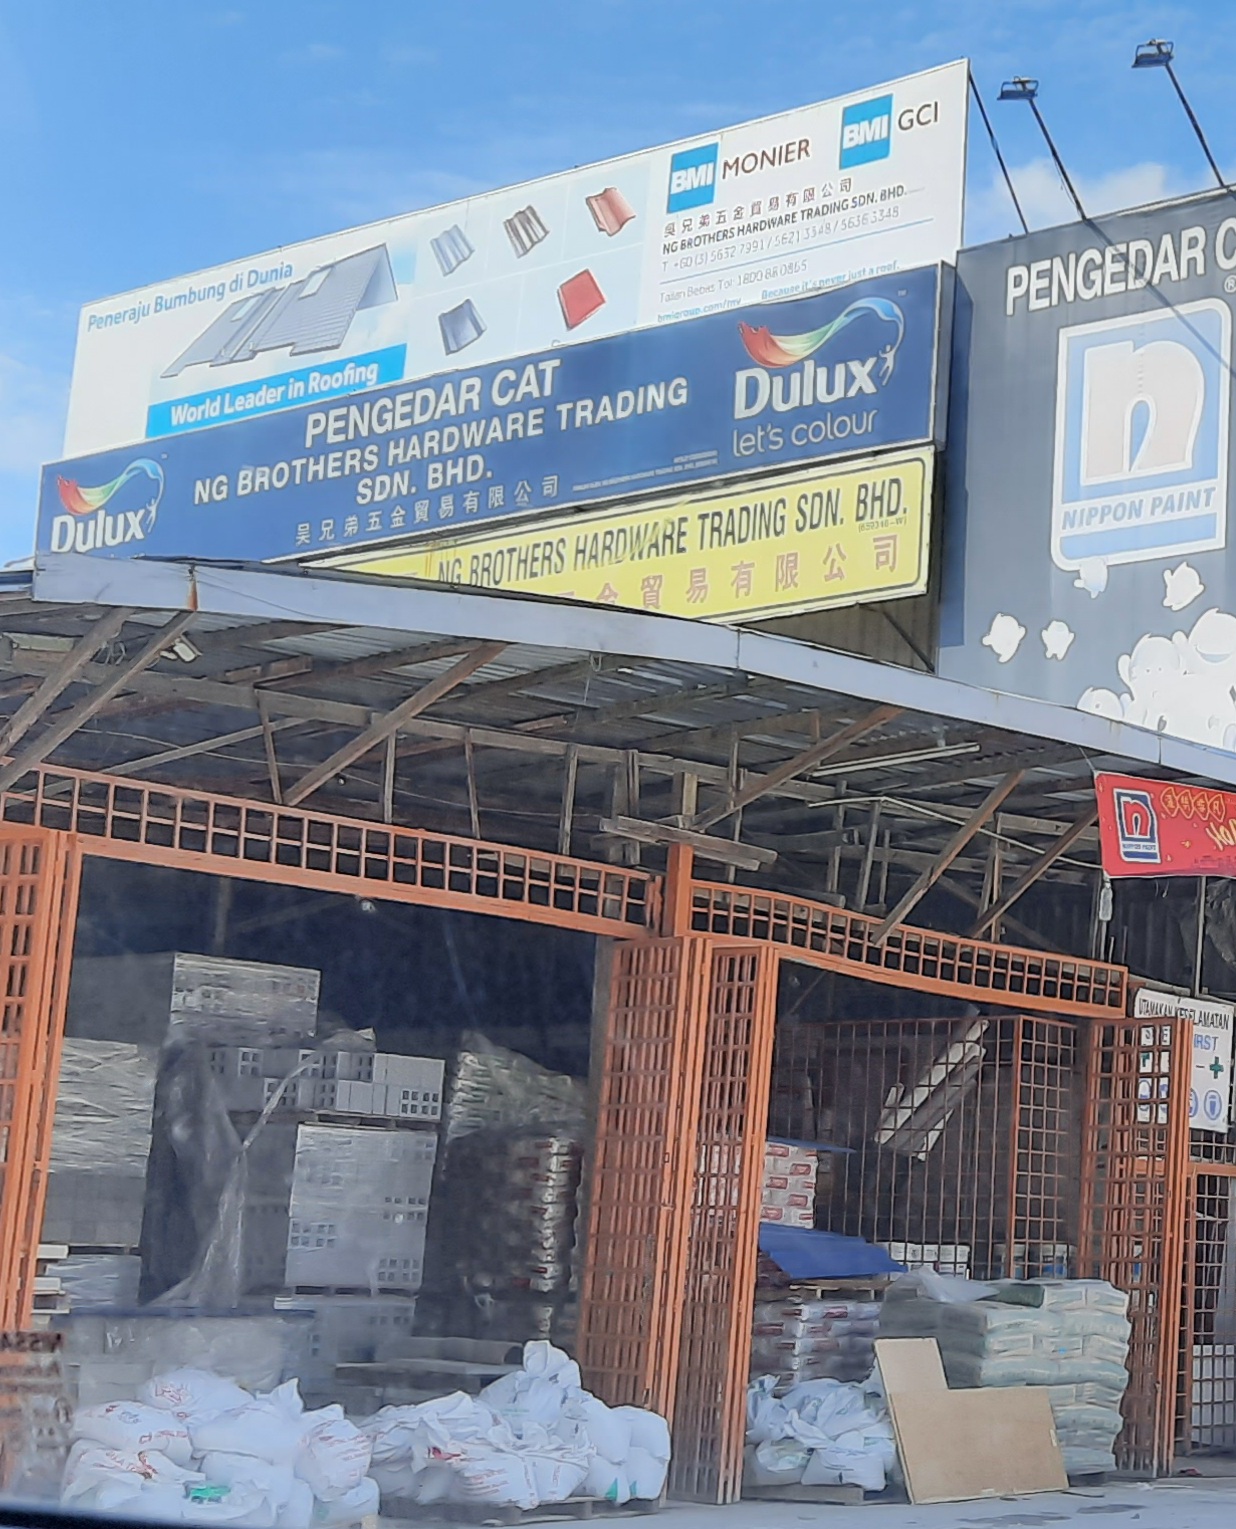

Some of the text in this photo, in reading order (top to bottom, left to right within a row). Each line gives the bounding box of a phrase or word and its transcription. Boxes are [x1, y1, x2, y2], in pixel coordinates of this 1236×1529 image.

[842, 114, 889, 149] BMI
[897, 101, 939, 132] GCI
[669, 161, 715, 195] BMI
[722, 139, 811, 180] MONIER
[662, 241, 678, 255] NG
[680, 227, 735, 250] BROTHERS
[737, 212, 797, 236] HARDWARE
[801, 200, 849, 220] TRADING
[851, 193, 877, 209] SDN.
[880, 185, 907, 202] BHD.
[87, 262, 293, 333] Peneraju Bumbung di Dunia
[1006, 226, 1206, 316] PENGEDAR
[170, 361, 378, 426] World Leader in Roofing
[305, 358, 561, 449] PENGEDAR CAT
[733, 355, 877, 420] Dulux
[193, 377, 689, 505] NG BROTHERS HARDWARE TRADING
[732, 408, 877, 458] let's colour
[356, 453, 492, 505] SDN. BHD.
[1061, 486, 1216, 530] NIPPON PAINT
[51, 509, 145, 553] Dulux
[469, 538, 566, 587] BROTHERS
[573, 516, 688, 572] HARDWARE
[698, 497, 786, 551] TRADING
[795, 489, 844, 533] SDN.
[855, 476, 907, 522] BHD.
